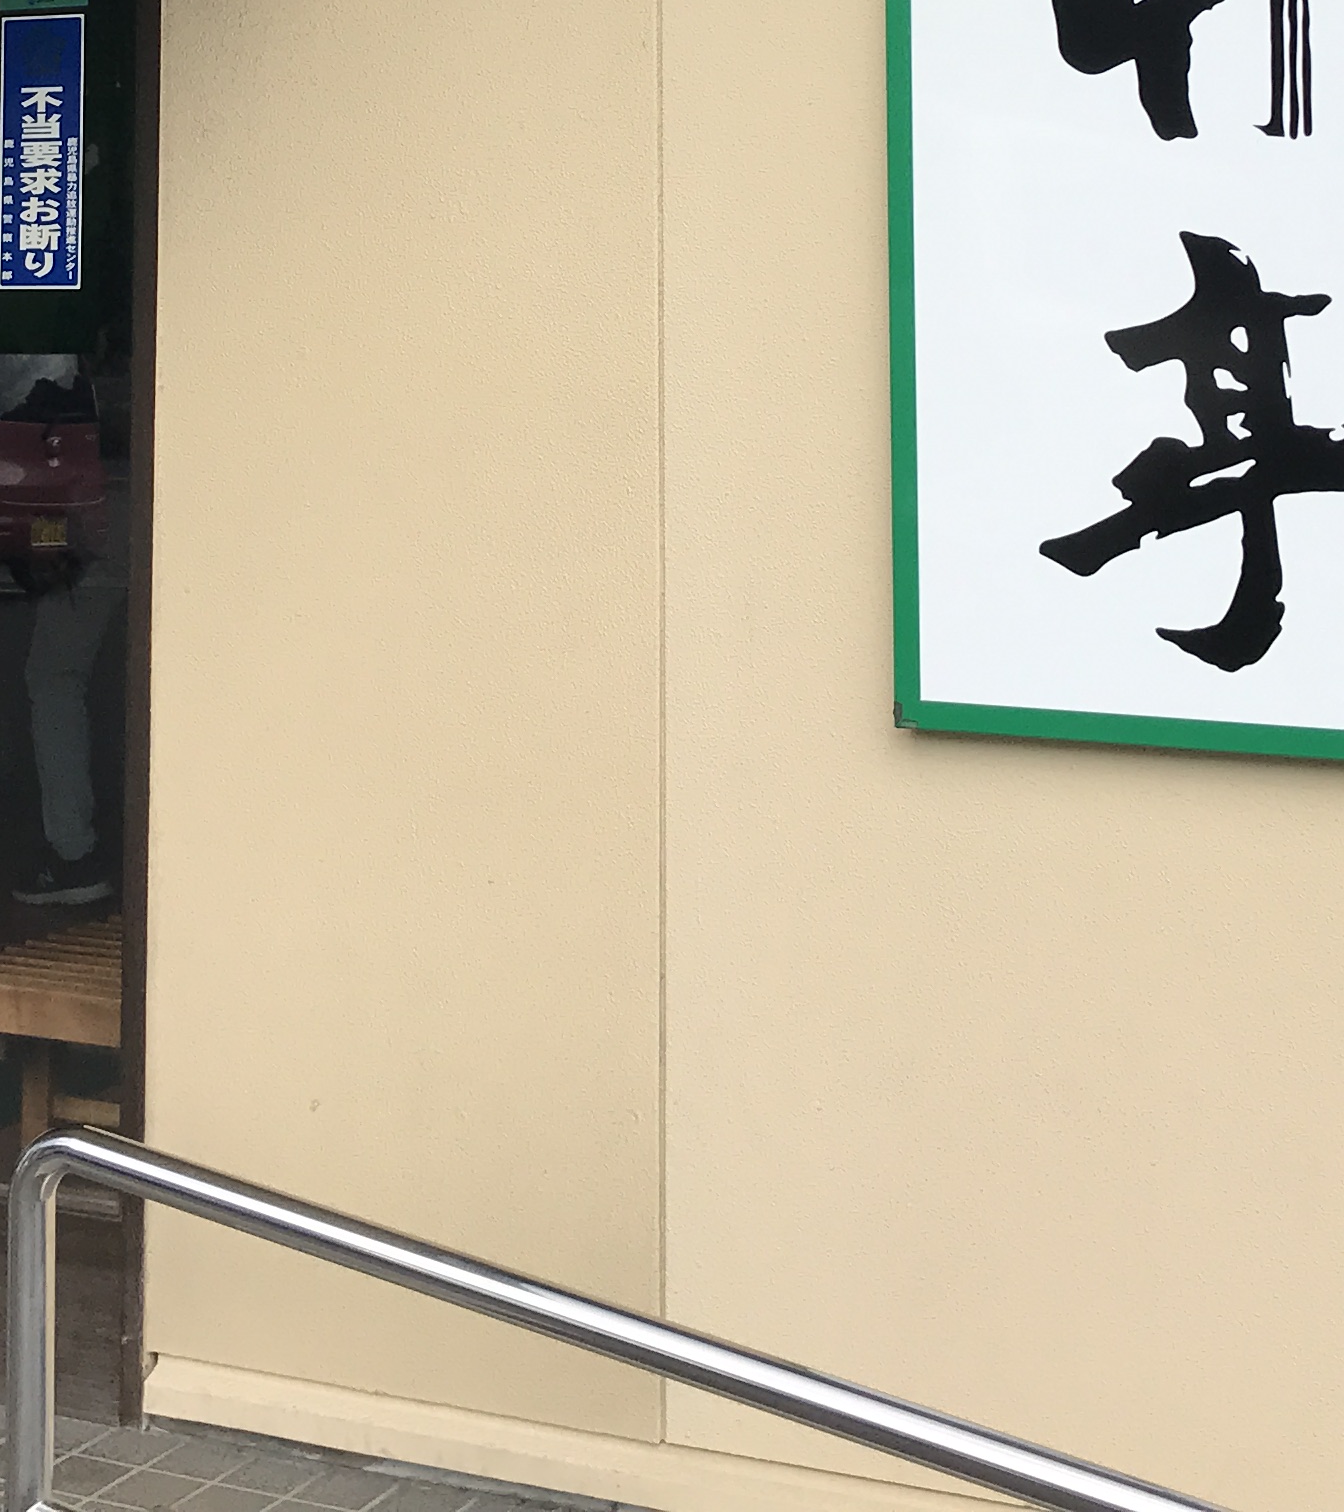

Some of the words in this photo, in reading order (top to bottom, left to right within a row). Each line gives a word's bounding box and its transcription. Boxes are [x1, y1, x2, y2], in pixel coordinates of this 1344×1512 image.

[18, 85, 64, 279] 不当要求お断り
